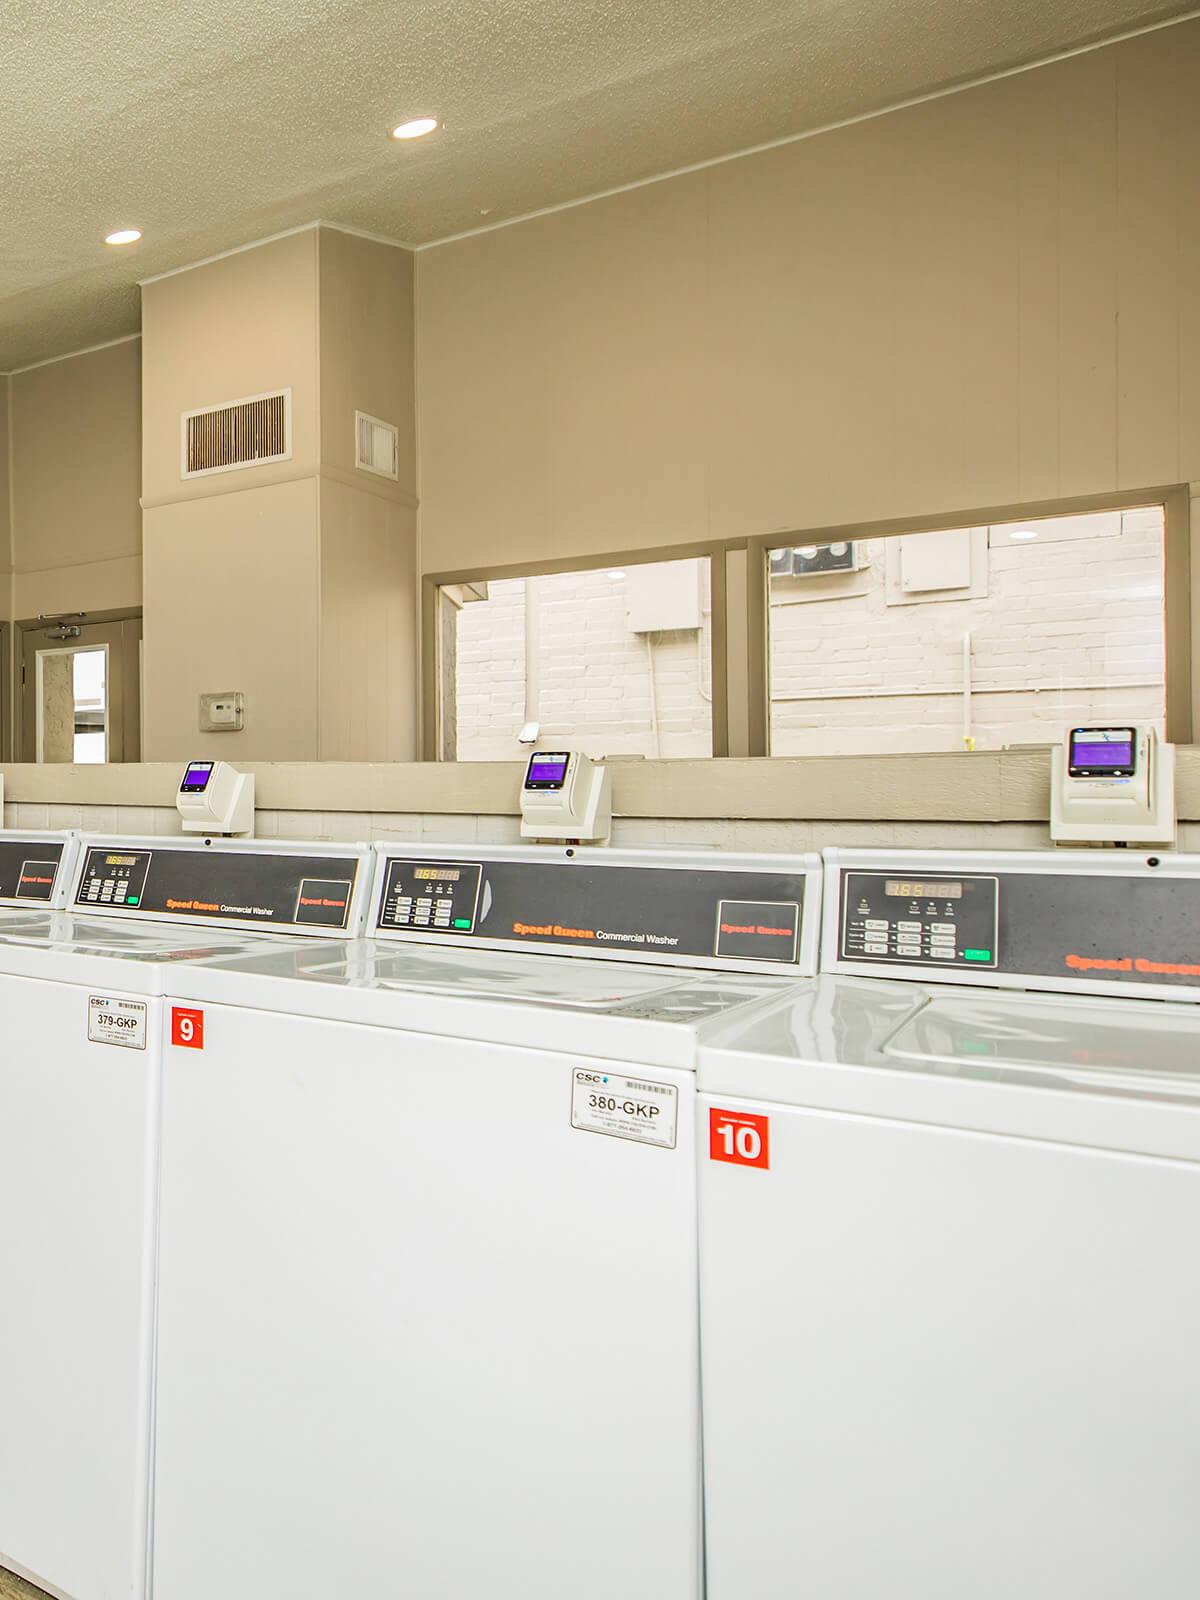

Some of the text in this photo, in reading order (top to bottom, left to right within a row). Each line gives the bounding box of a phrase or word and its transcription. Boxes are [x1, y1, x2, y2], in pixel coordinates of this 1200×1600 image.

[166, 899, 274, 916] Speed Queen Commercial Washer
[513, 923, 679, 946] Speed Queen Commercial Washer
[1065, 954, 1133, 972] Speed
[90, 998, 105, 1006] CSC
[97, 1014, 138, 1030] 379-GKP
[180, 1018, 194, 1042] 9
[576, 1072, 601, 1083] CSC
[588, 1094, 661, 1119] 380-GKP
[716, 1123, 762, 1160] 10
